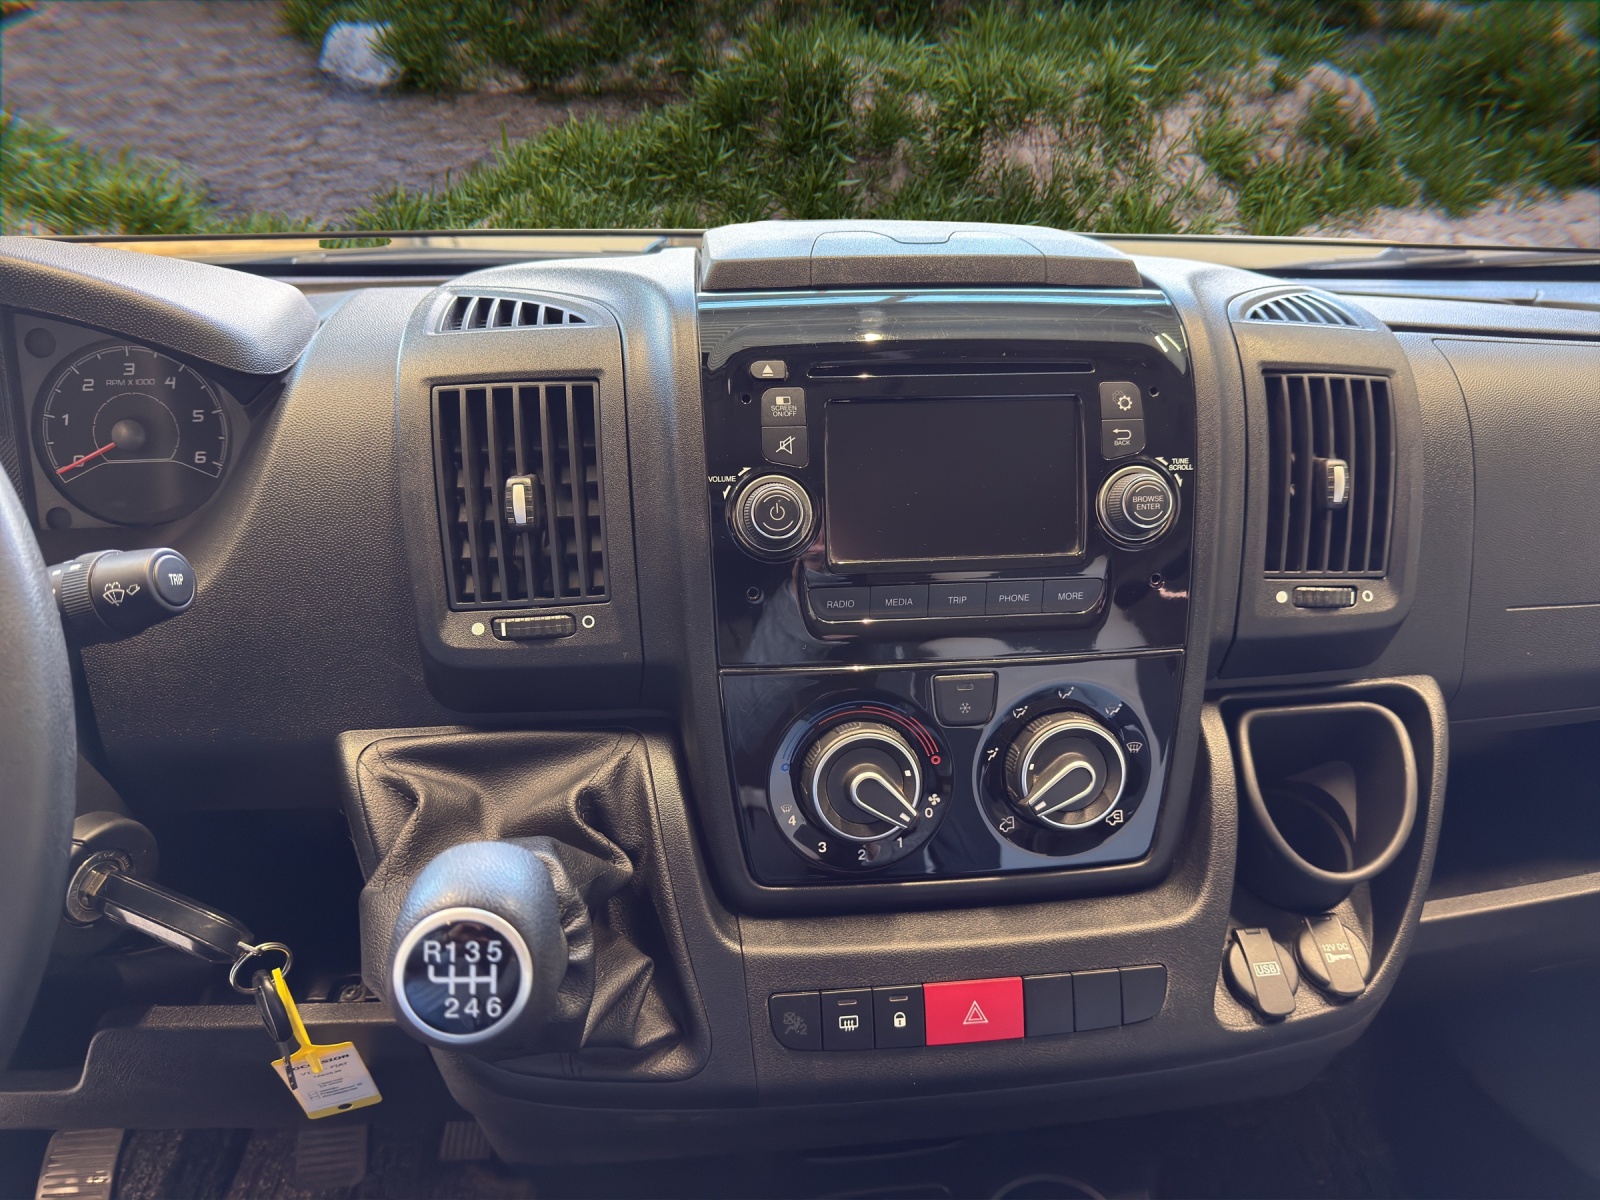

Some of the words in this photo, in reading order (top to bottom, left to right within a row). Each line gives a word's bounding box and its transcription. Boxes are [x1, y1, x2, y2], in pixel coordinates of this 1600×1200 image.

[123, 363, 136, 376] 3
[82, 379, 95, 391] 2
[135, 378, 156, 386] 1000
[164, 377, 177, 389] 4
[61, 413, 69, 426] 1
[192, 410, 205, 422] 5
[194, 451, 207, 464] 6
[1132, 495, 1164, 503] BROWSE
[1136, 503, 1161, 511] ENTER
[168, 573, 184, 586] TRIP
[885, 597, 913, 607] MEDIA
[948, 596, 967, 605] TRIP
[999, 593, 1030, 602] PHONE
[1057, 591, 1084, 601] MORE
[826, 599, 855, 609] RADIO
[788, 815, 797, 826] 4
[818, 841, 827, 853] 3
[896, 836, 903, 848] 1
[857, 849, 867, 861] 2
[1322, 943, 1336, 951] 12V
[1337, 942, 1349, 950] DC
[1255, 963, 1278, 975] USB
[292, 1054, 350, 1070] OCSION
